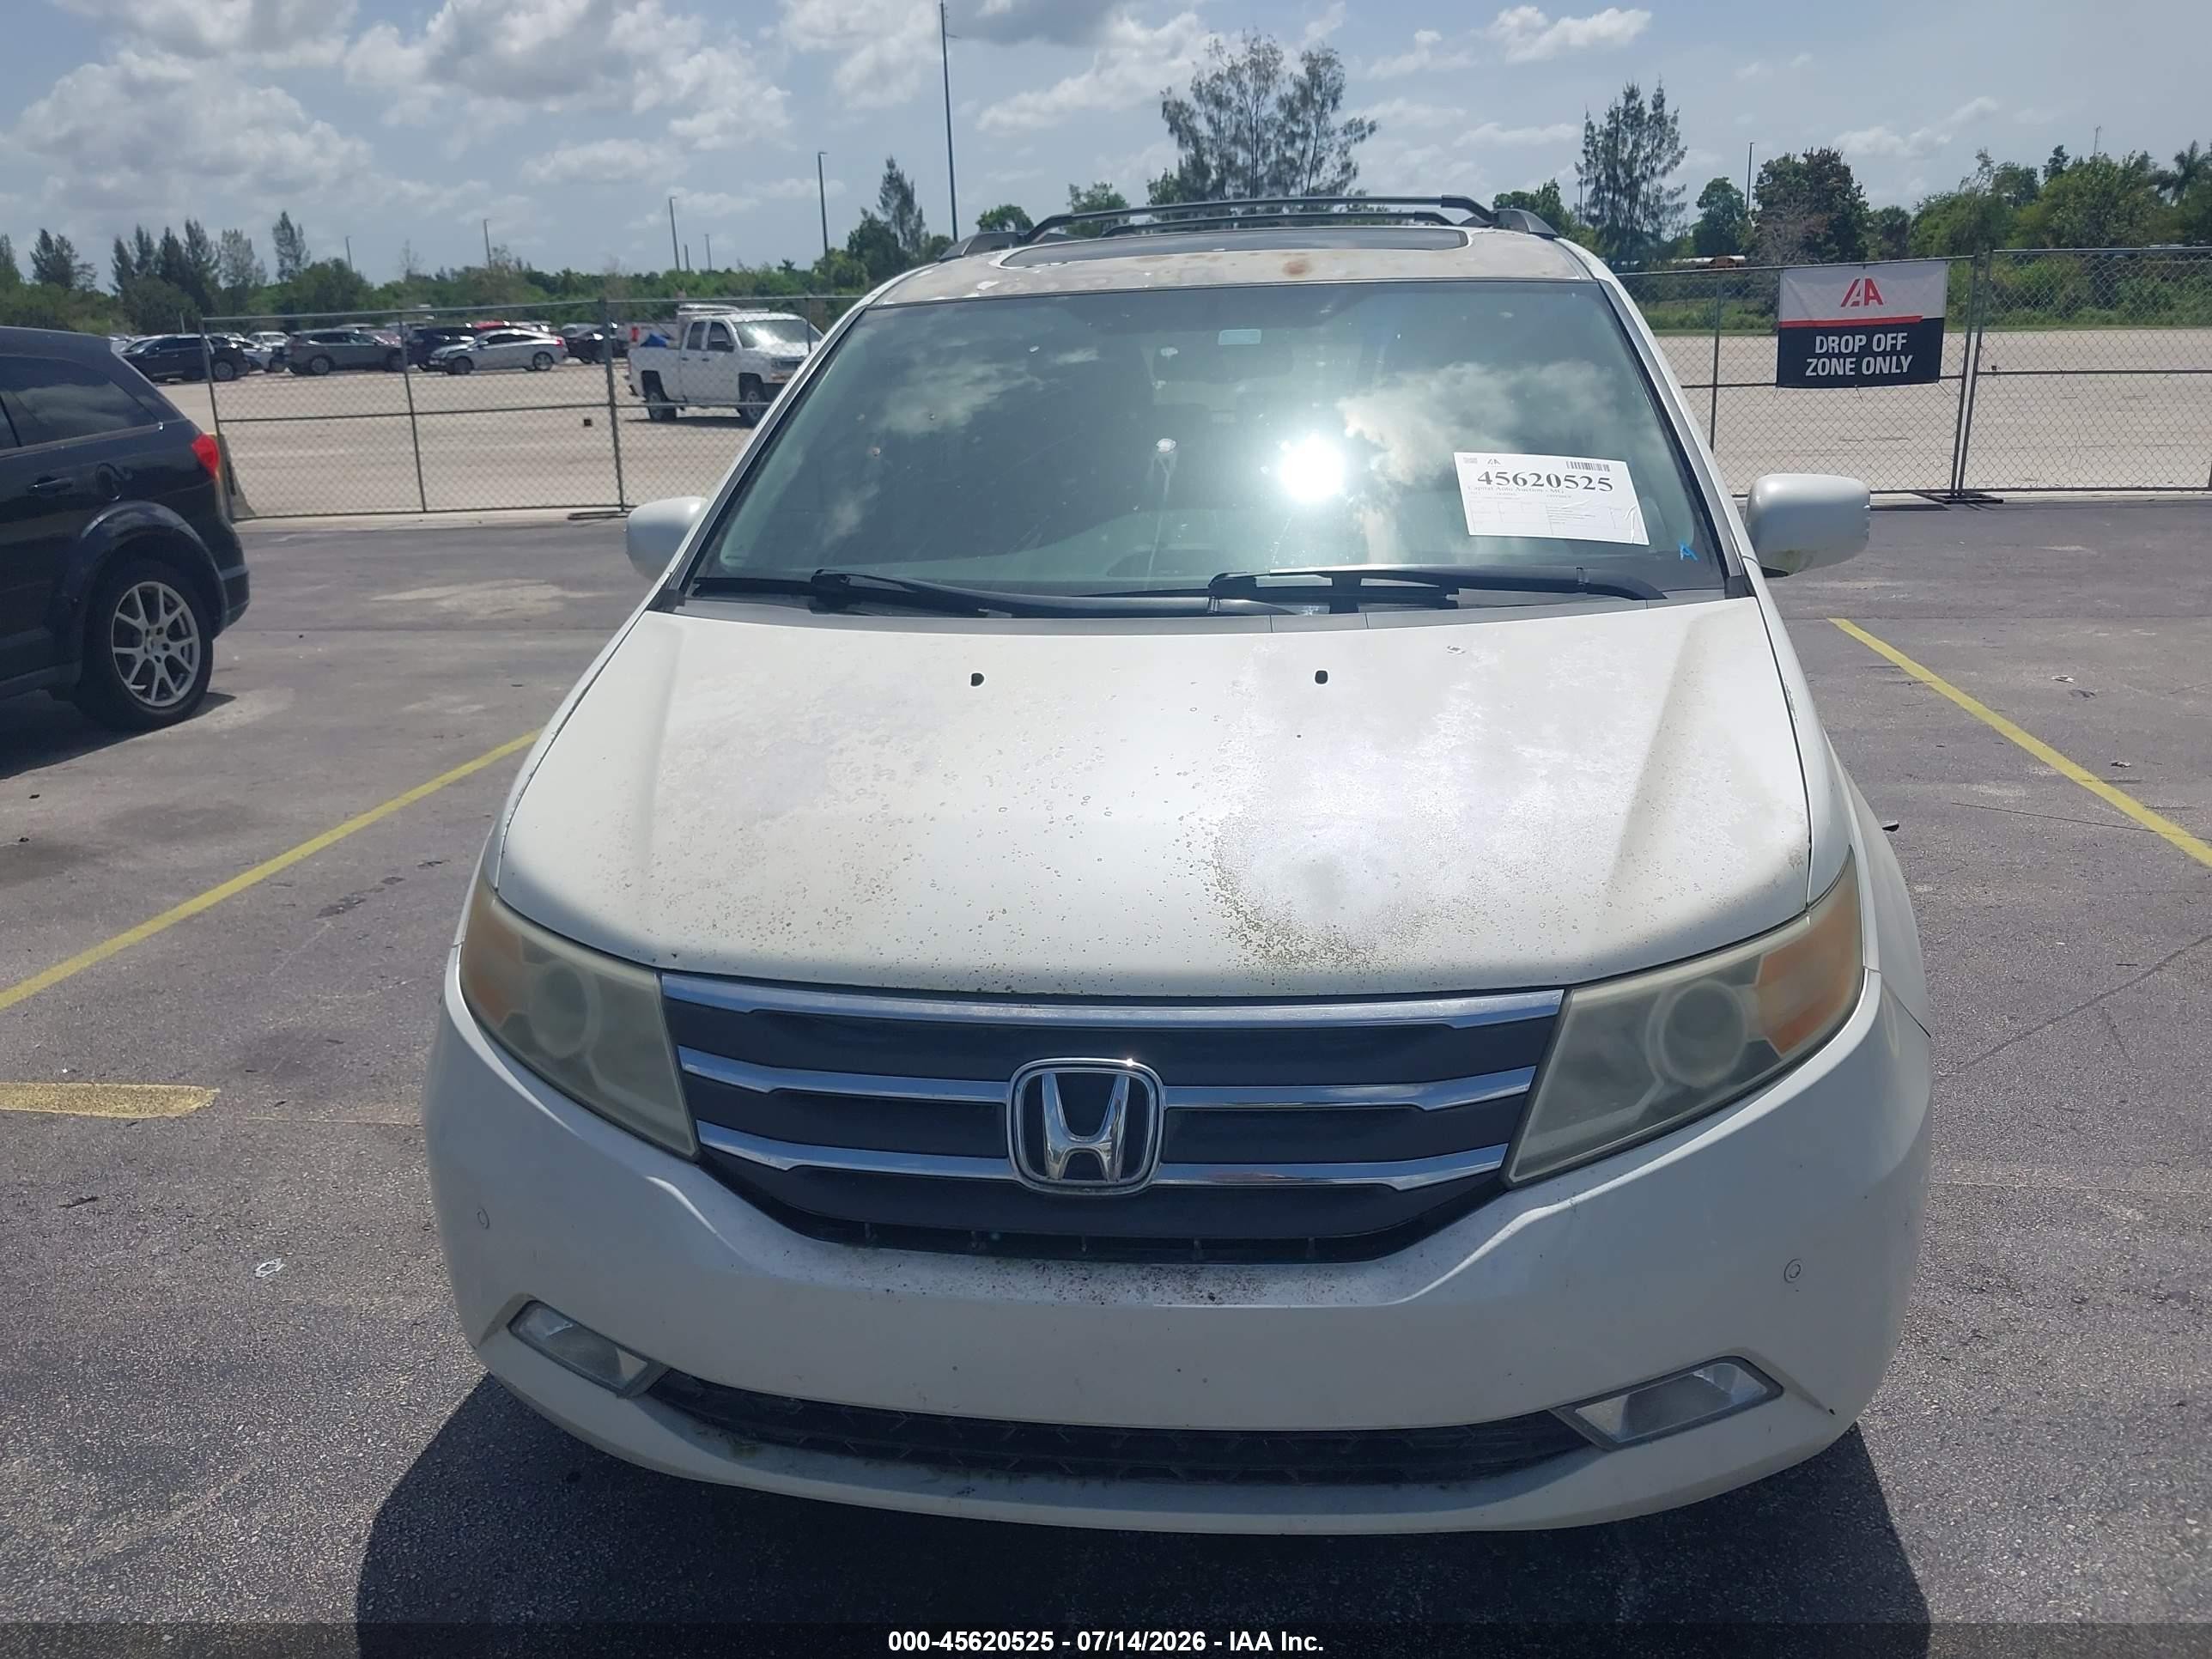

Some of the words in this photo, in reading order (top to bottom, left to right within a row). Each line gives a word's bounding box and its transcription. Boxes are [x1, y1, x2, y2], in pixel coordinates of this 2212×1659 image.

[1814, 335, 1867, 354] DROP
[1872, 332, 1908, 352] OFF
[1805, 357, 1856, 376] ZONE
[1862, 355, 1913, 374] ONLY
[1477, 471, 1613, 492] 45620525
